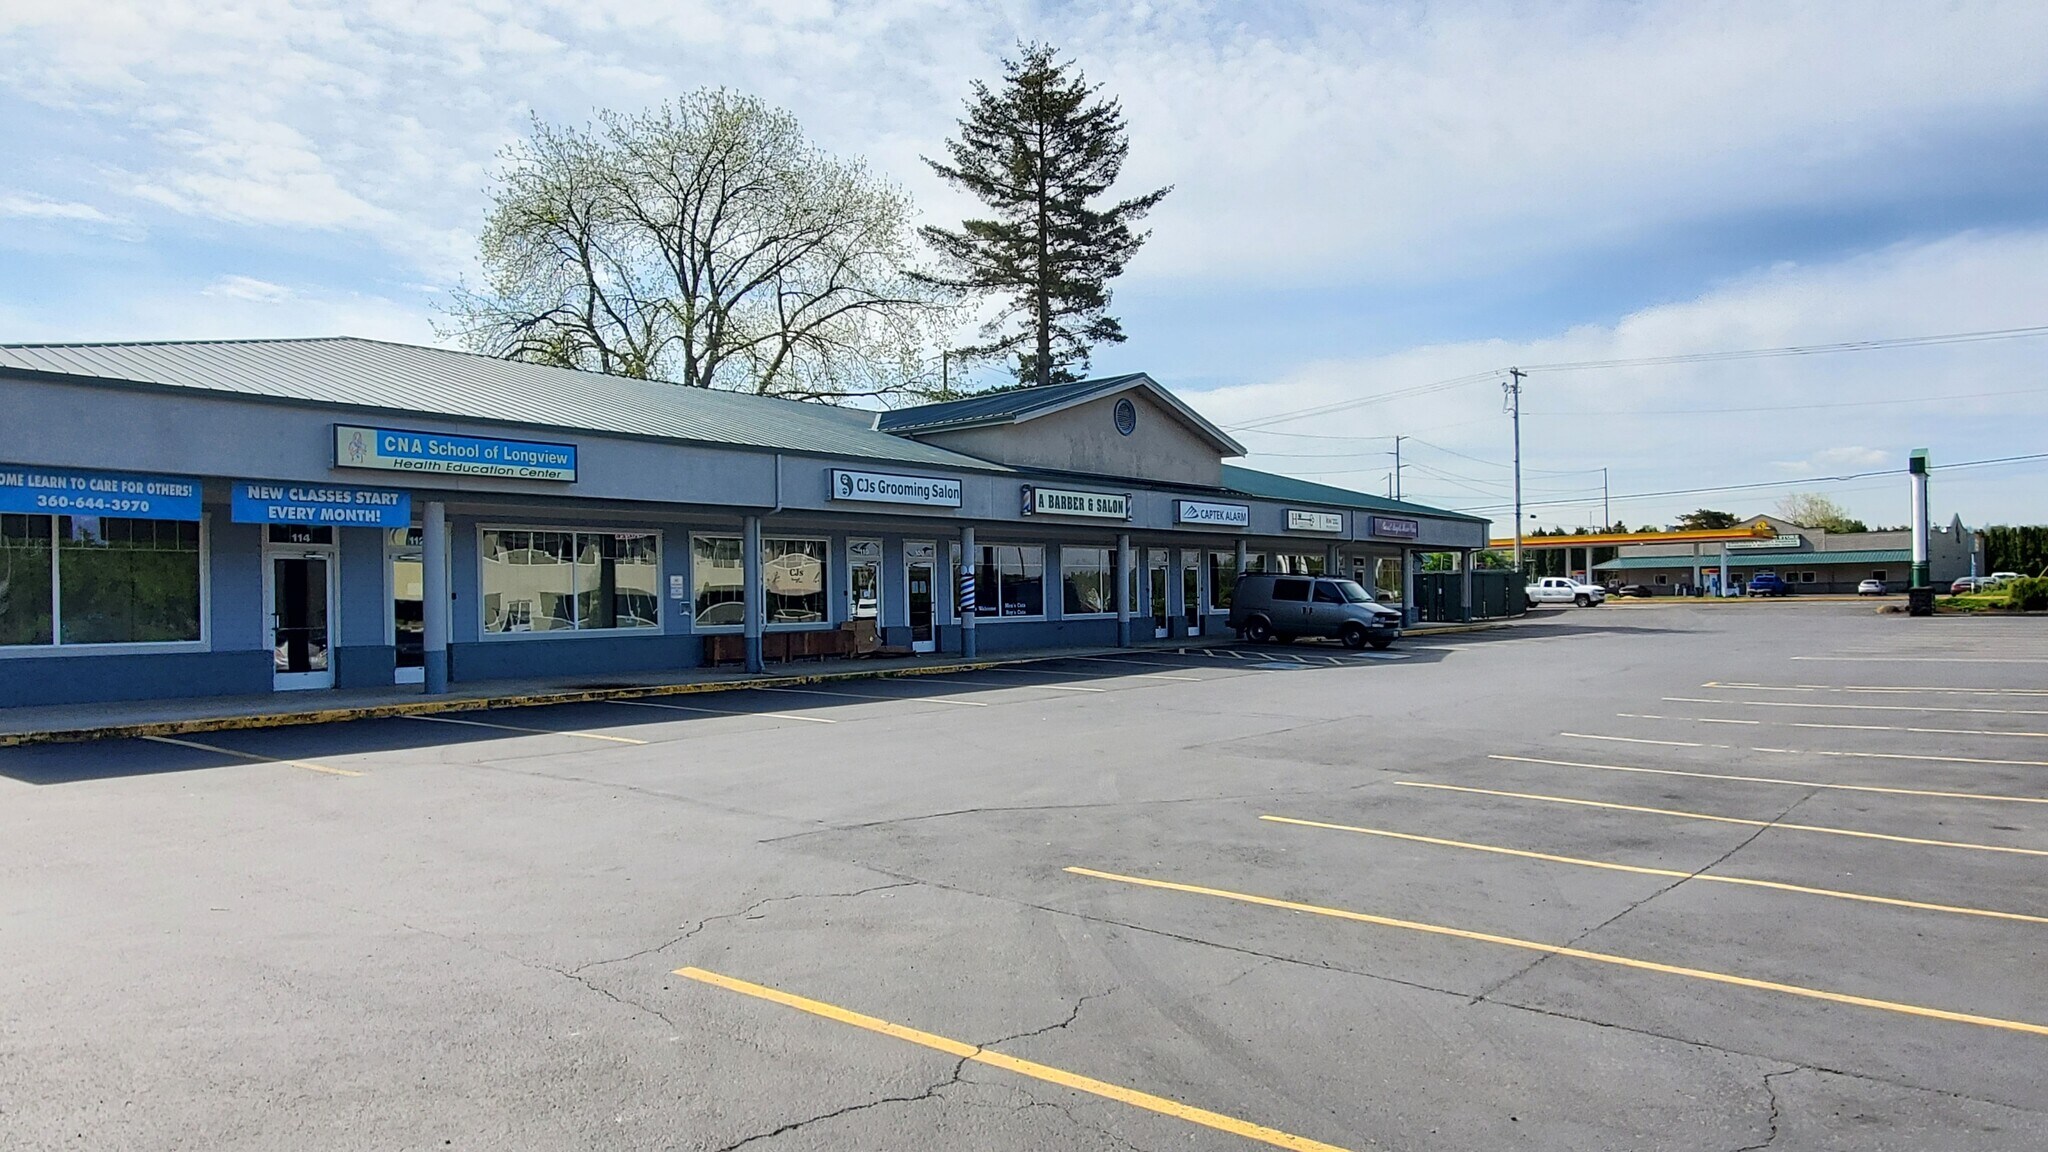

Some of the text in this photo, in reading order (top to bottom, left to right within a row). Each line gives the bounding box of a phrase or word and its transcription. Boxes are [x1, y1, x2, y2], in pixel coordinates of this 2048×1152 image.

[384, 436, 568, 466] CNA School of Longview
[393, 458, 562, 479] Health Education Center
[0, 473, 192, 497] OME LEARN TO CARE FOR OTHERS!
[248, 485, 398, 505] NEW CLASSES START
[856, 477, 960, 500] CJs Grooming Salon
[37, 495, 150, 513] 360-644-3970
[1038, 493, 1124, 514] A BARBER & SALON
[268, 506, 381, 523] EVERY MONTH!
[1200, 509, 1247, 522] CAPTEK ALARM
[291, 533, 311, 543] 114
